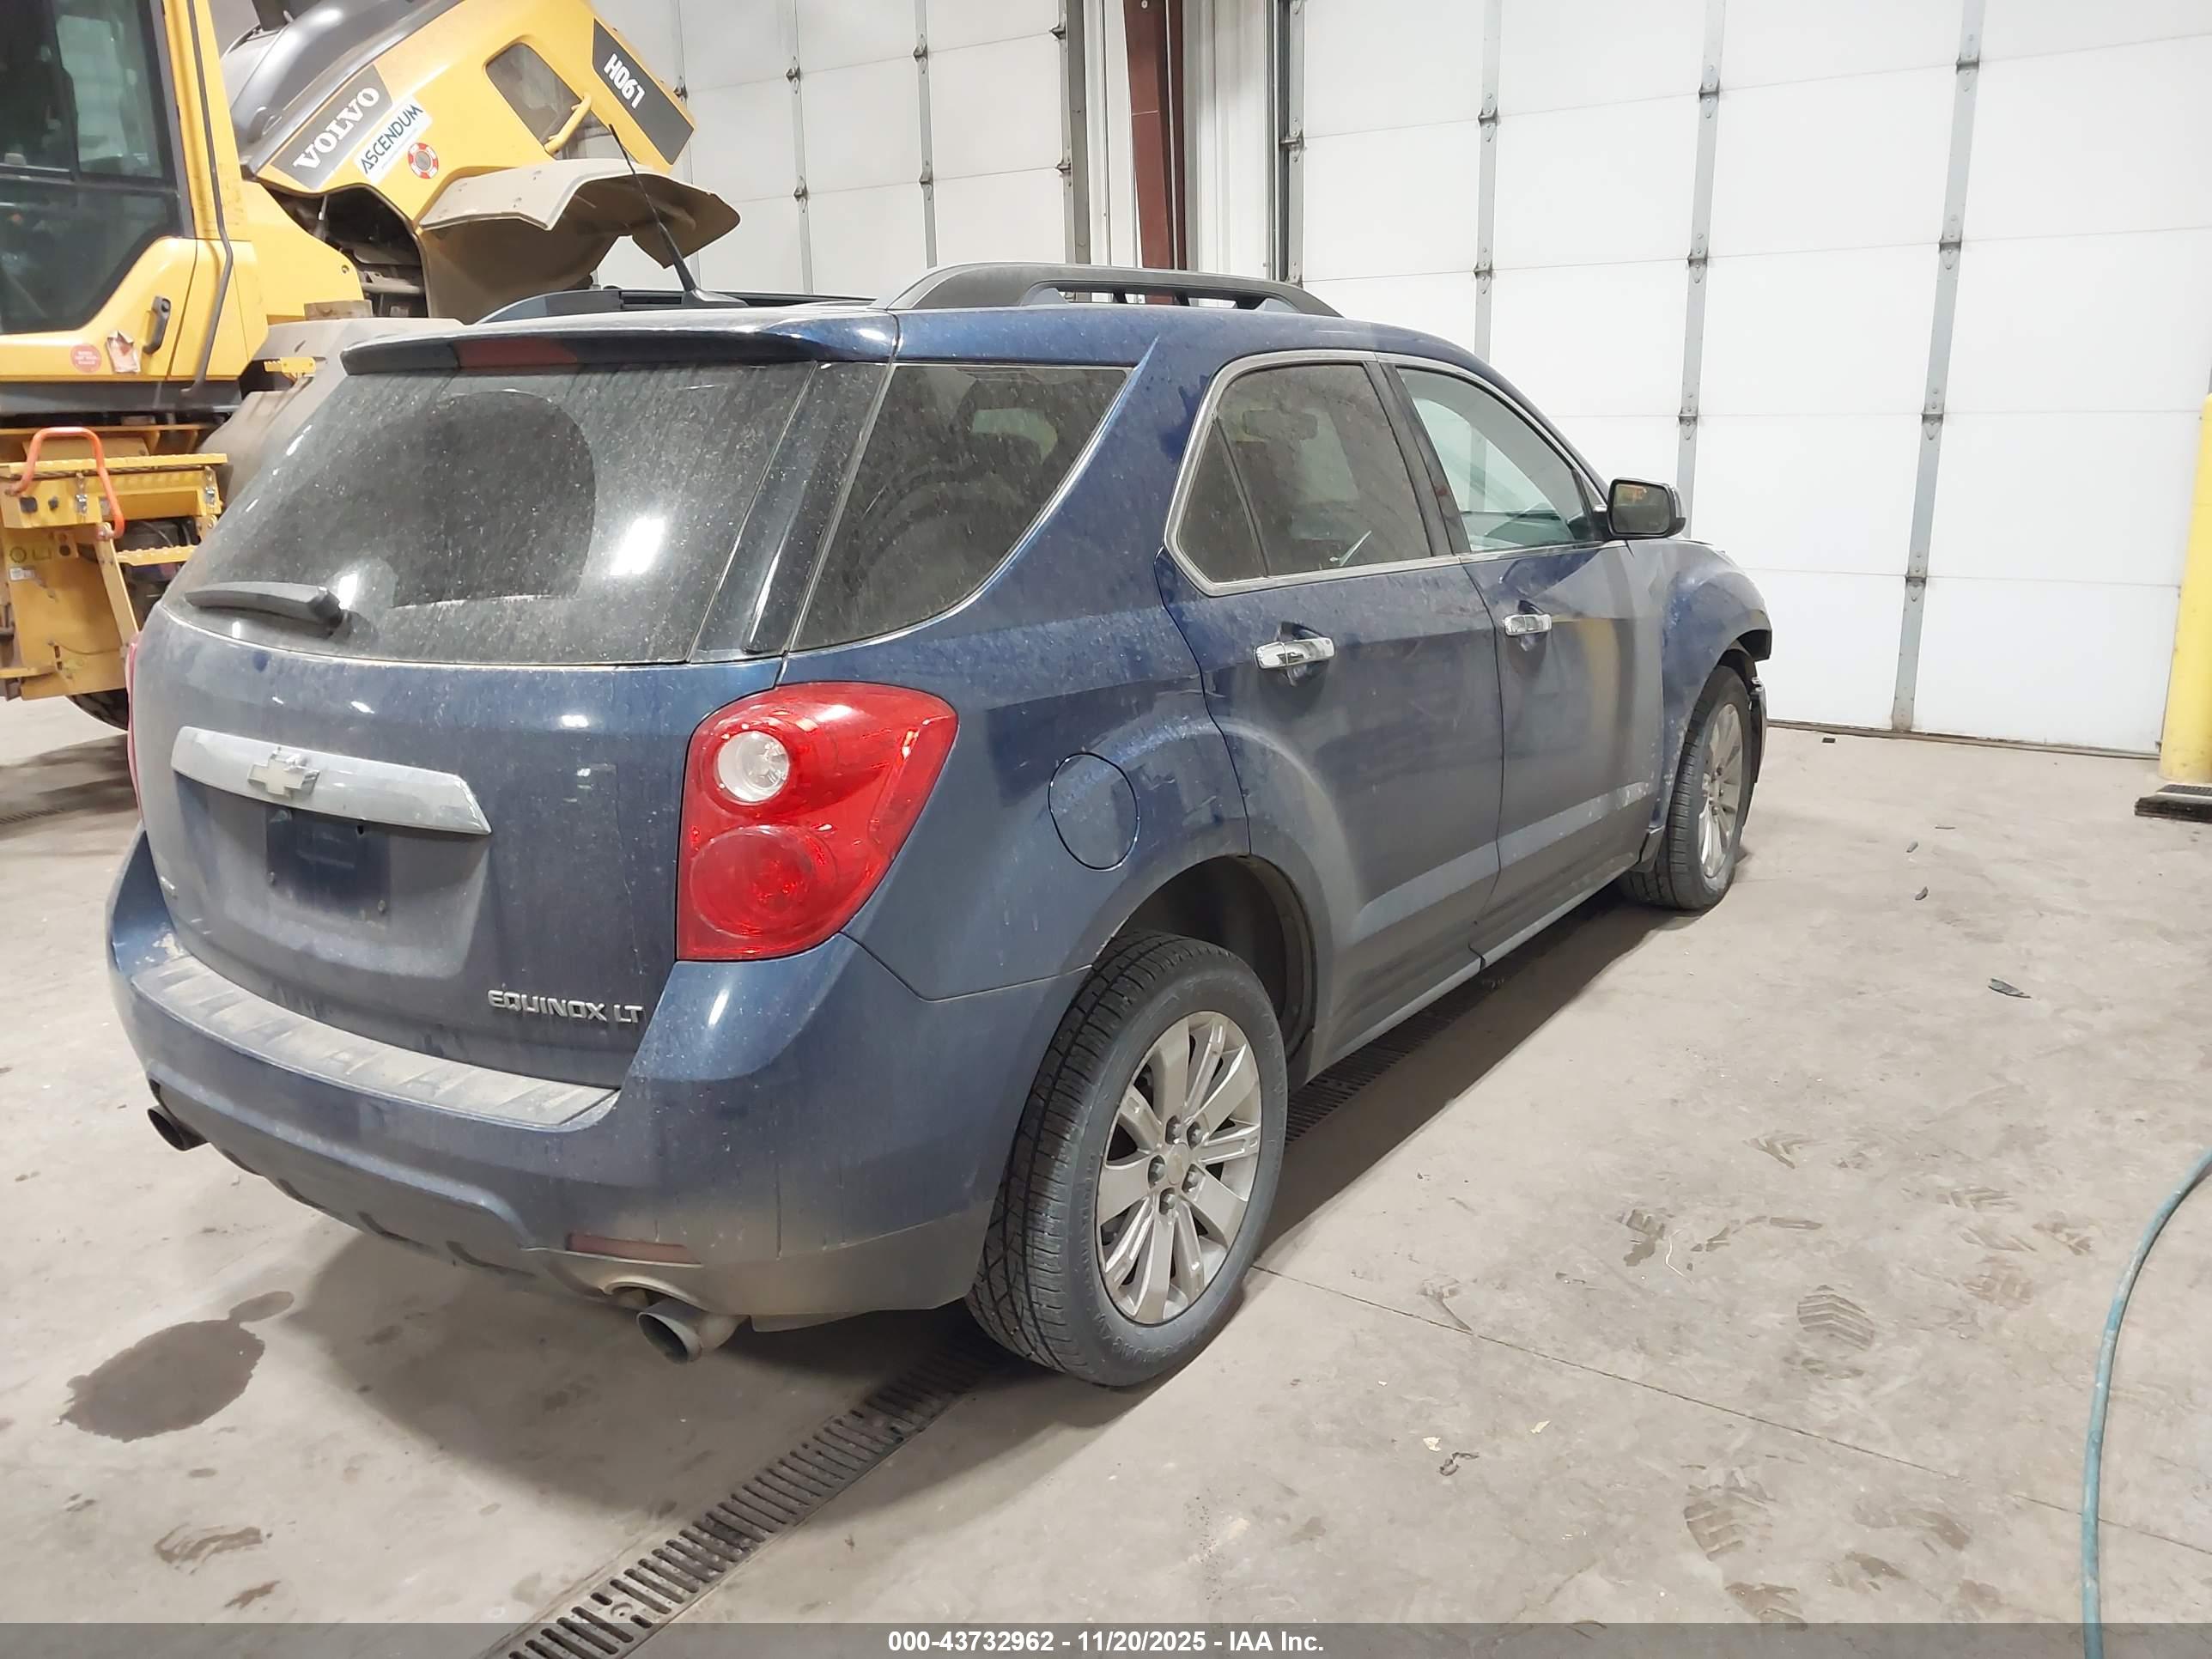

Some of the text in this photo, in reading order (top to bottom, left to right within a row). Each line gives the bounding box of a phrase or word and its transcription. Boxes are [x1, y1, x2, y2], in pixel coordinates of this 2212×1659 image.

[293, 87, 380, 169] VOLVO
[361, 104, 423, 174] ASCENDUM
[488, 989, 643, 1024] EQUINOX LT
